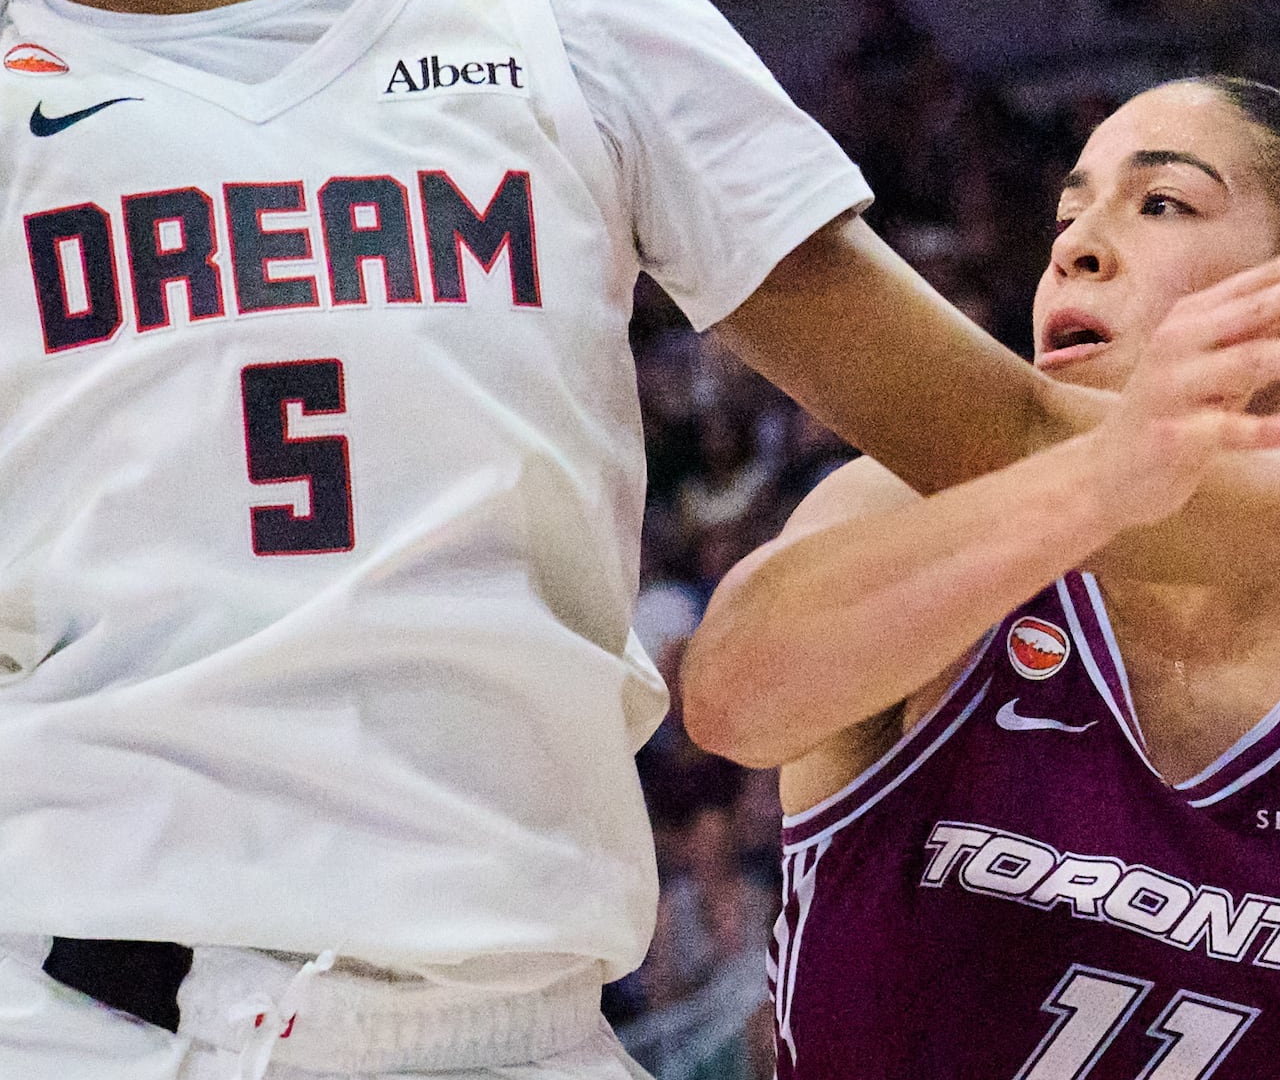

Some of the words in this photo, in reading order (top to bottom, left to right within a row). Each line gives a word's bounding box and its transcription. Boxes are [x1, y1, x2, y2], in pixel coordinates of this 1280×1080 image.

[386, 54, 524, 96] Albert
[23, 170, 544, 355] DREAM
[240, 358, 356, 557] 5
